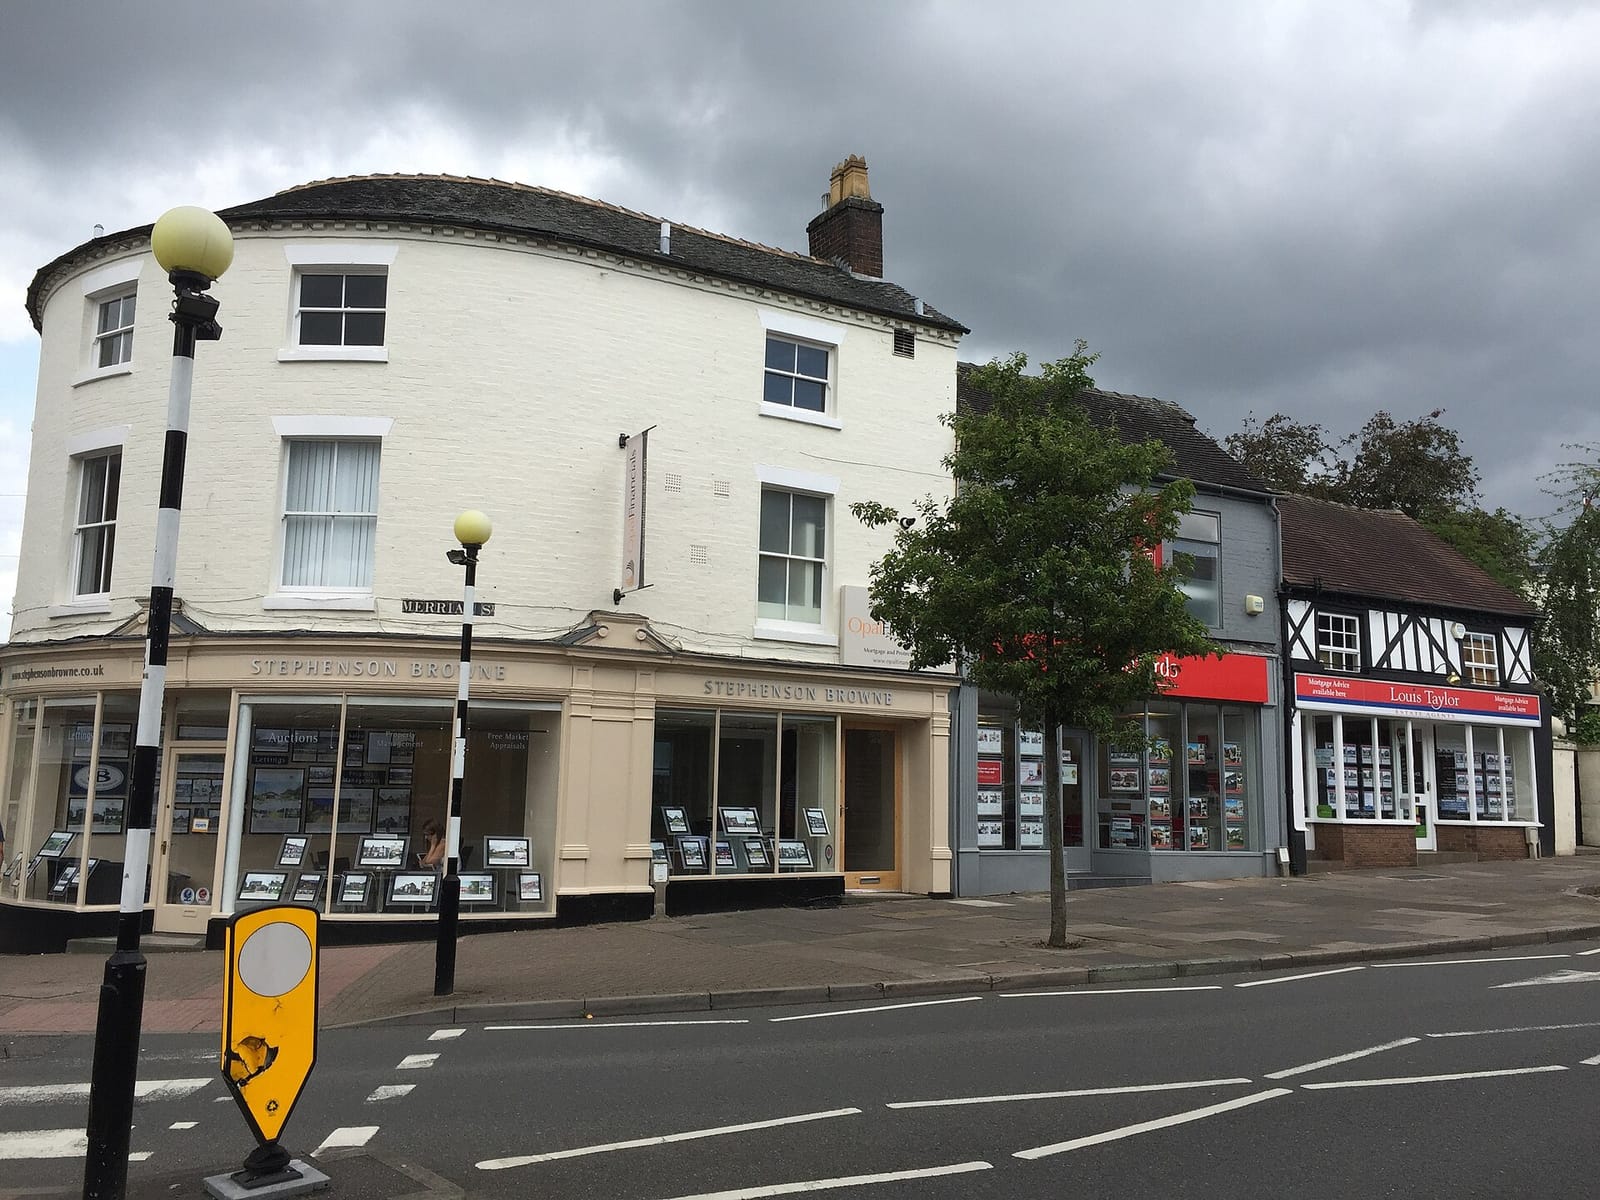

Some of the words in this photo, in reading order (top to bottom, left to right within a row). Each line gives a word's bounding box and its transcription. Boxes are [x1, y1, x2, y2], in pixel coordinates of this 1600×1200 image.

[402, 600, 465, 614] MERRIA
[251, 659, 398, 677] STEPHENSON
[1308, 677, 1332, 689] Mortgage
[1333, 682, 1350, 690] Advice
[703, 679, 817, 701] STEPHENSON
[825, 687, 893, 706] BROWNE
[1312, 688, 1335, 698] available
[1335, 690, 1347, 698] here
[1390, 687, 1422, 704] Louis
[1424, 689, 1460, 711] Taylor
[1494, 694, 1515, 705] Mortgage
[1514, 697, 1529, 706] Advice
[1395, 709, 1423, 717] ESTATE
[1425, 711, 1456, 719] AGENTS
[1498, 704, 1516, 713] available
[1517, 705, 1527, 714] here
[268, 732, 319, 744] Auctions
[487, 732, 503, 740] Free
[505, 733, 529, 741] Market
